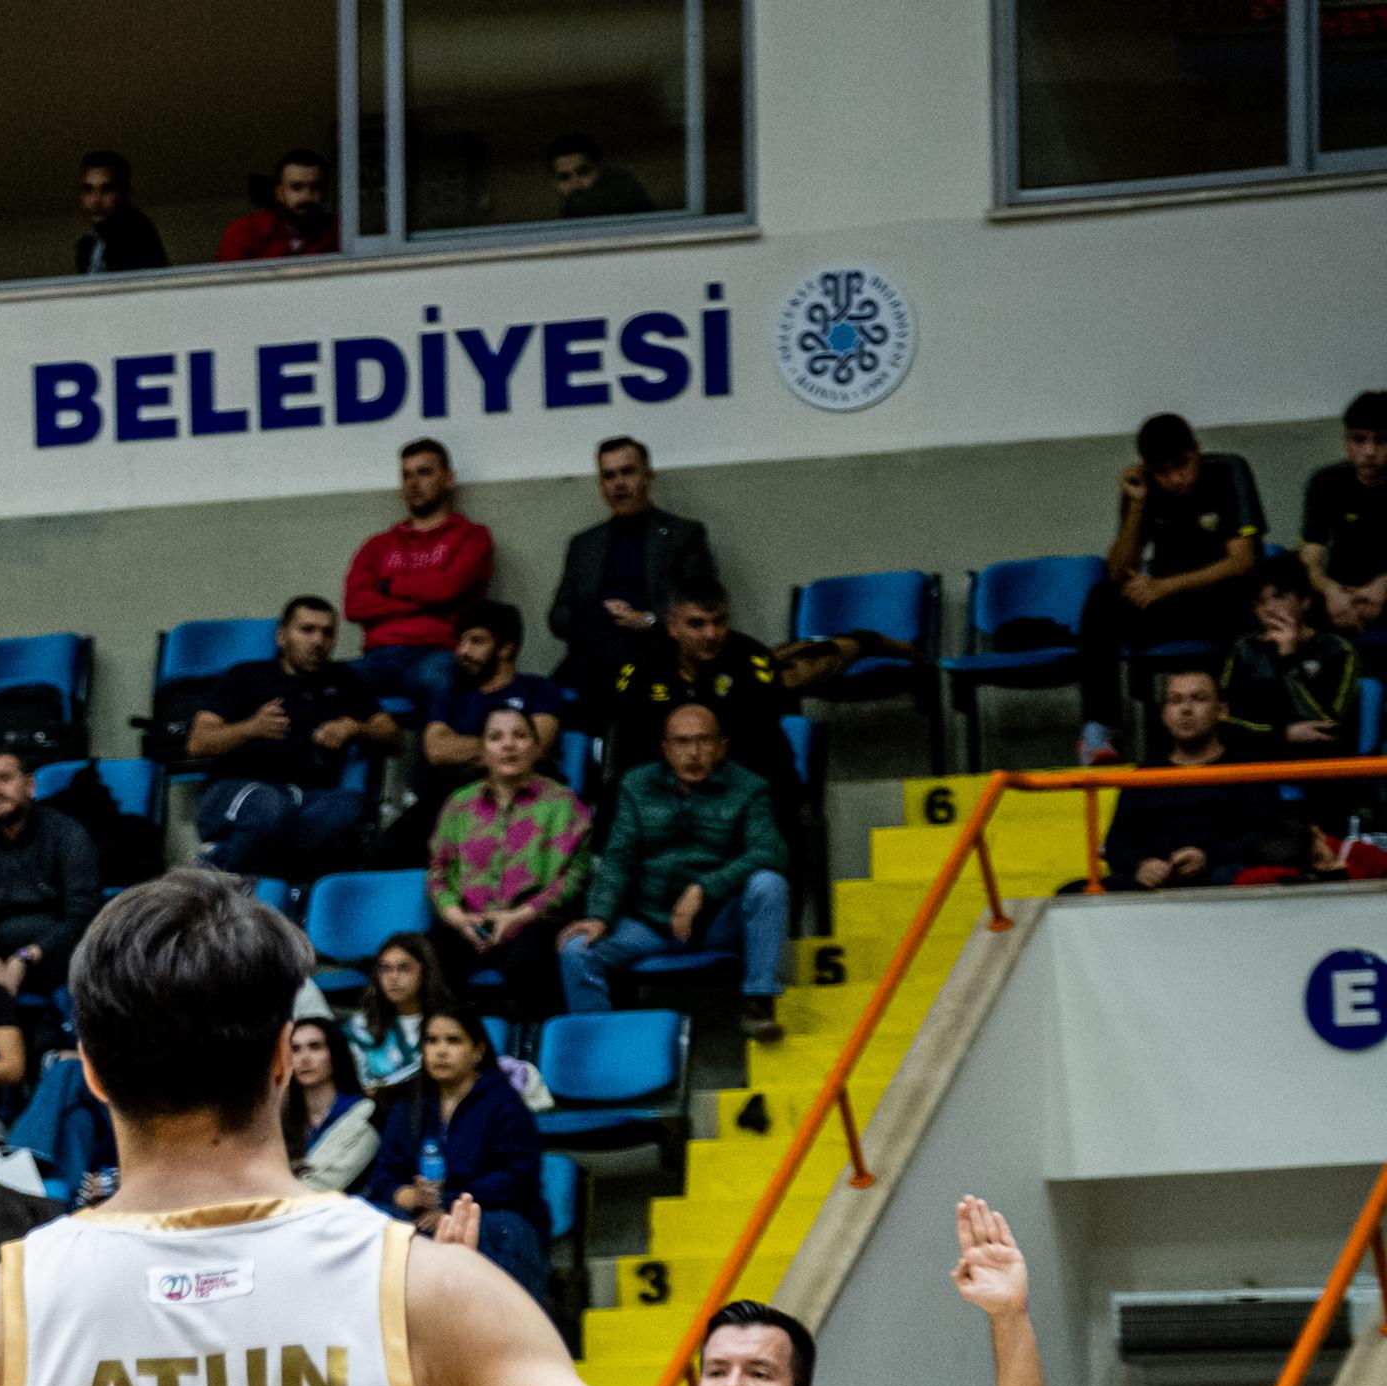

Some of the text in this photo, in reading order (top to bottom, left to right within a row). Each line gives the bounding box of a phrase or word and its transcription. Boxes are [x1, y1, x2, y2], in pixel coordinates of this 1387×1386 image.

[33, 282, 732, 449] BELEDİYESİ
[922, 787, 956, 826] 6
[814, 945, 846, 986] 5
[737, 1094, 771, 1135] 4
[635, 1260, 671, 1305] 3
